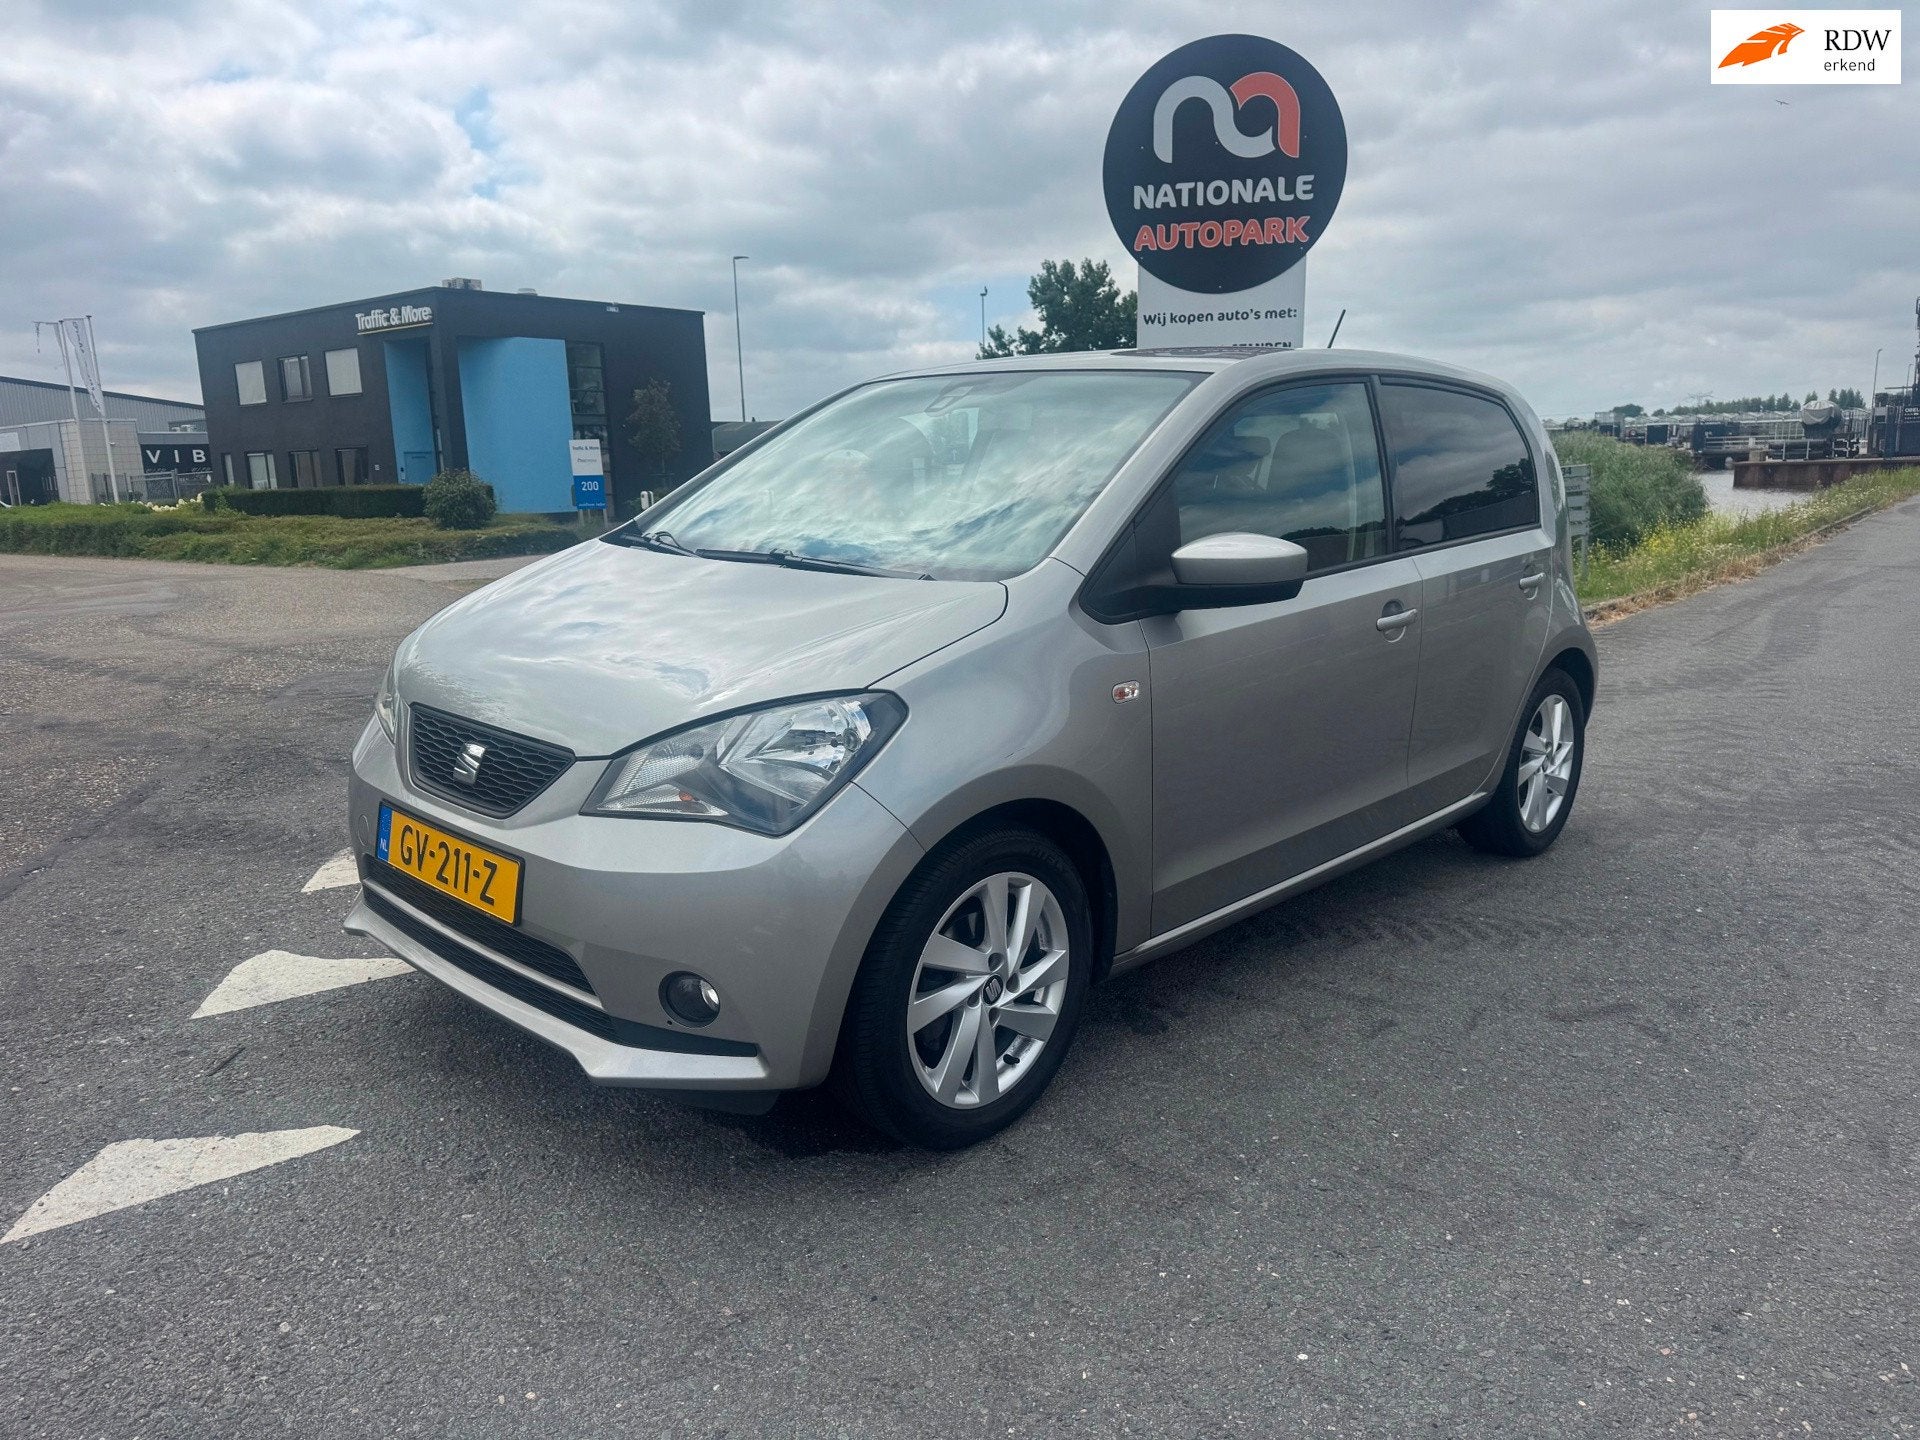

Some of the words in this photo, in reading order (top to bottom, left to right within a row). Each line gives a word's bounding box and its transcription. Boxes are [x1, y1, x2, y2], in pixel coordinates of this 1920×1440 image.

[1133, 174, 1315, 210] NATIONALE
[1133, 215, 1311, 252] AUTOPARK
[355, 308, 389, 330] Traffic
[389, 307, 401, 326] &
[401, 305, 432, 324] More
[1143, 312, 1167, 327] Wij
[1170, 311, 1214, 325] kopen
[1217, 308, 1261, 322] auto's
[1264, 307, 1298, 320] met:
[581, 481, 599, 491] 200
[380, 837, 388, 852] NL
[400, 824, 498, 907] GV-211-Z
